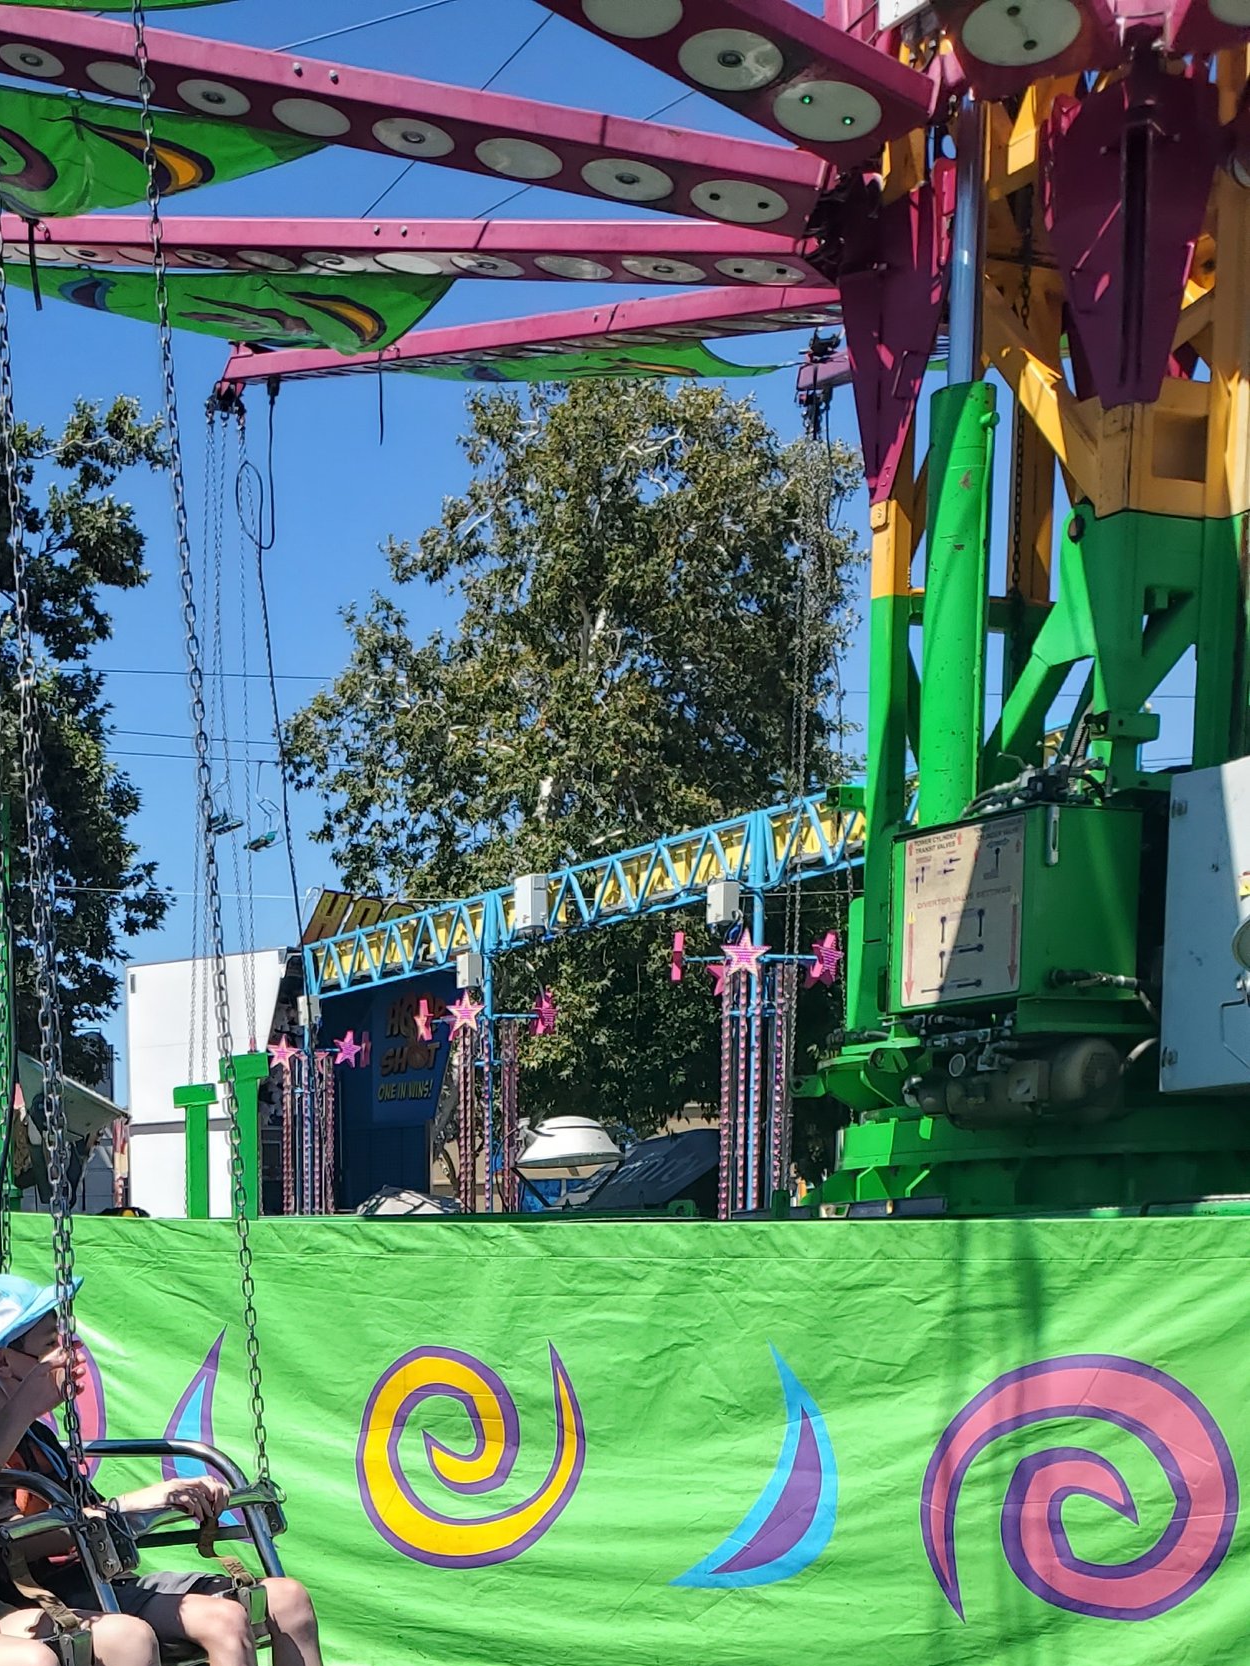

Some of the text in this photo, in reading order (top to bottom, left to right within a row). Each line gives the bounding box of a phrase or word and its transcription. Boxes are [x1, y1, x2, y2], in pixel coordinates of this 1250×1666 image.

[932, 832, 957, 844] CYLINDER
[916, 840, 956, 854] TRANSIT VALVES
[378, 1079, 434, 1101] ONE IN WINS!
